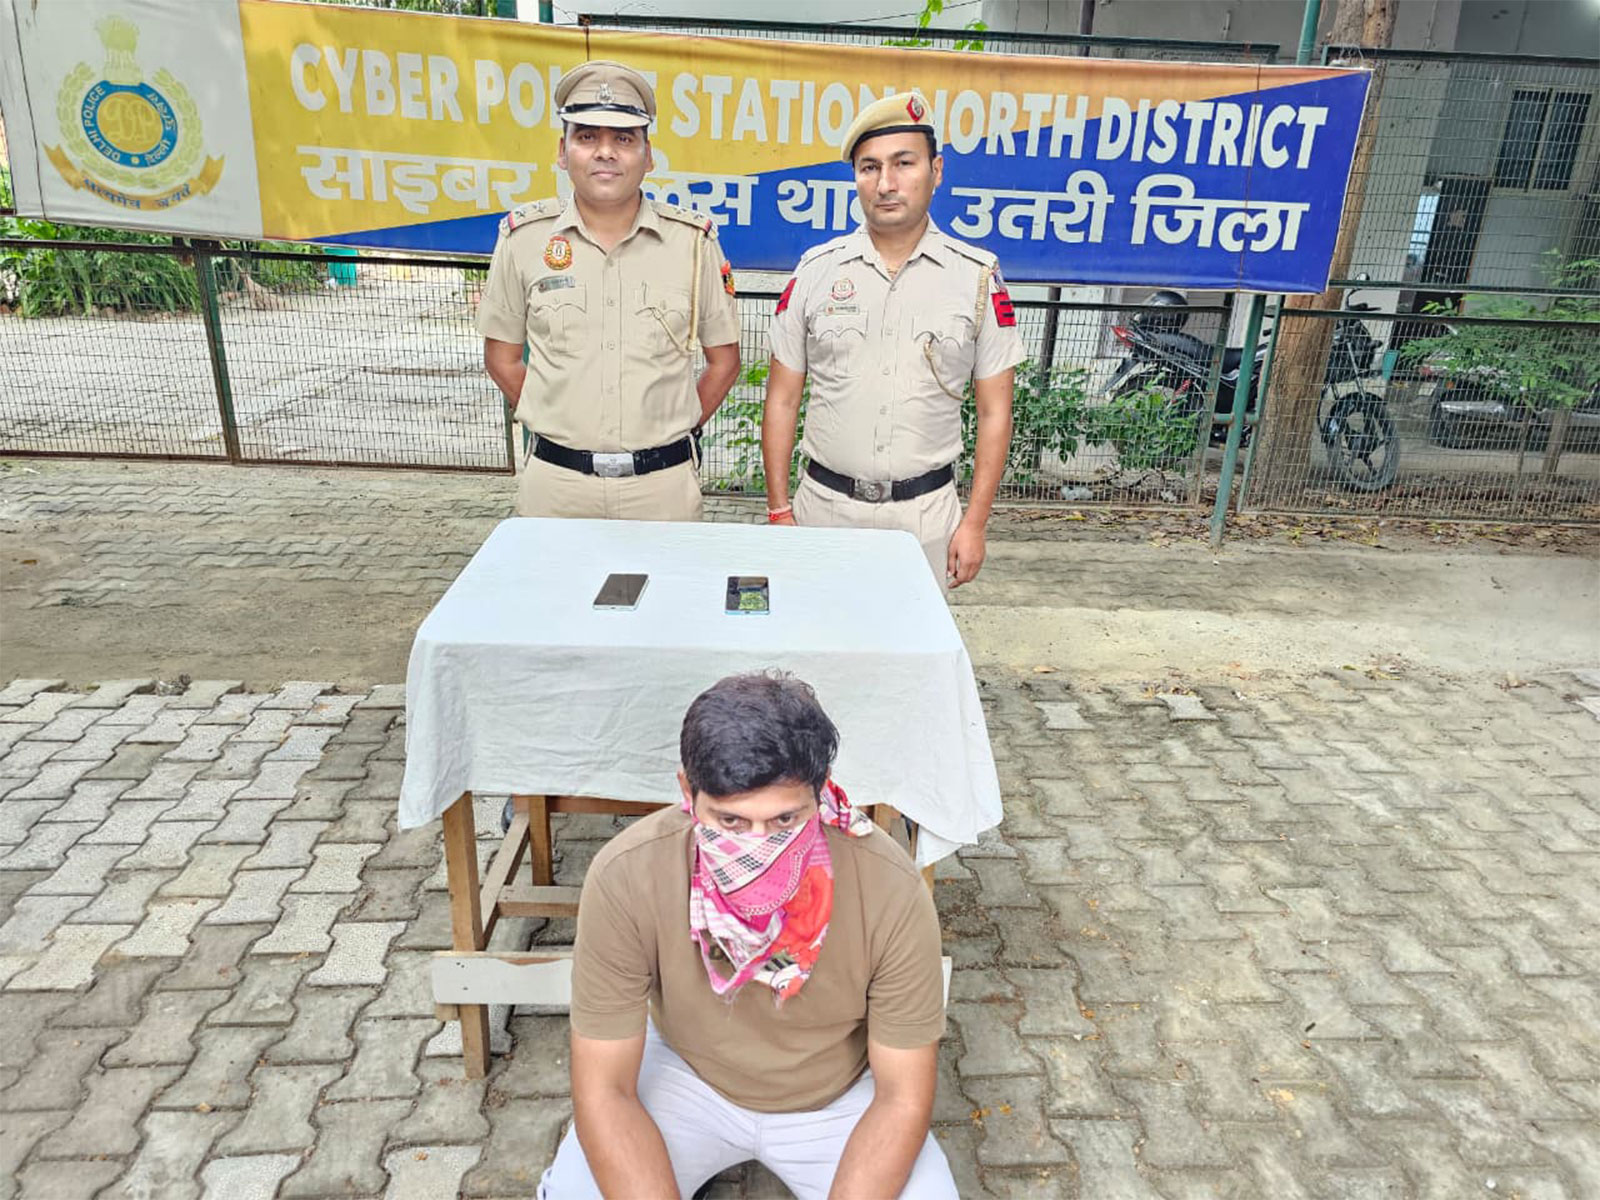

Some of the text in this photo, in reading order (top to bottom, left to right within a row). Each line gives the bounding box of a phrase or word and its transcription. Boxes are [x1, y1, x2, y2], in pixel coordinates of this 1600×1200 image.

[83, 85, 121, 162] DELHI POLICE
[291, 45, 462, 122] CYBER
[477, 59, 657, 133] POL
[1098, 97, 1329, 170] DISTRICT
[297, 146, 537, 214] साइबर
[950, 169, 1115, 244] उतरी
[1130, 173, 1310, 253] जिला
